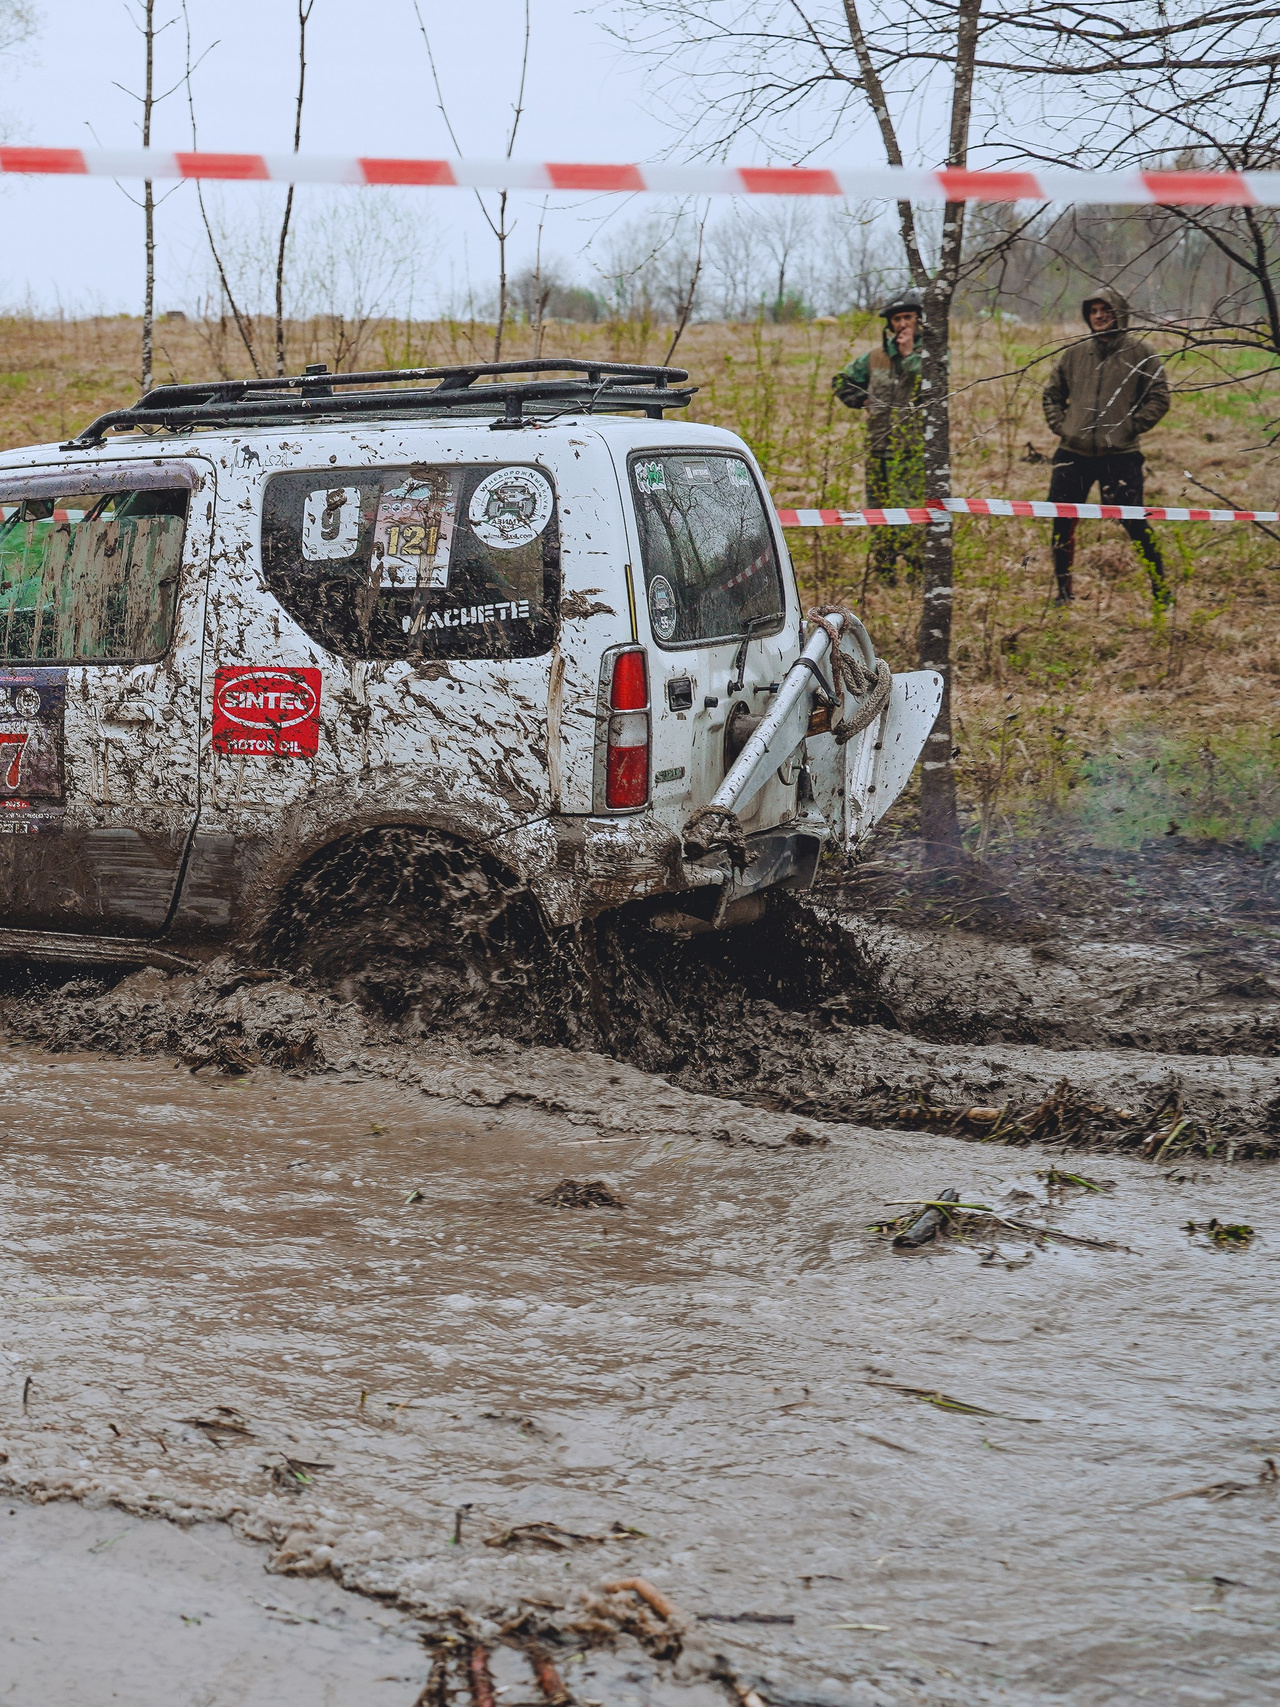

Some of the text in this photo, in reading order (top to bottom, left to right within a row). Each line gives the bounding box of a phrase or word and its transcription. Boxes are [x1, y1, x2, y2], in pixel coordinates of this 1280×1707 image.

[386, 525, 439, 556] 121
[401, 599, 530, 634] MACHETE
[223, 691, 309, 710] SINTEC
[228, 739, 302, 753] MOTOR OIL
